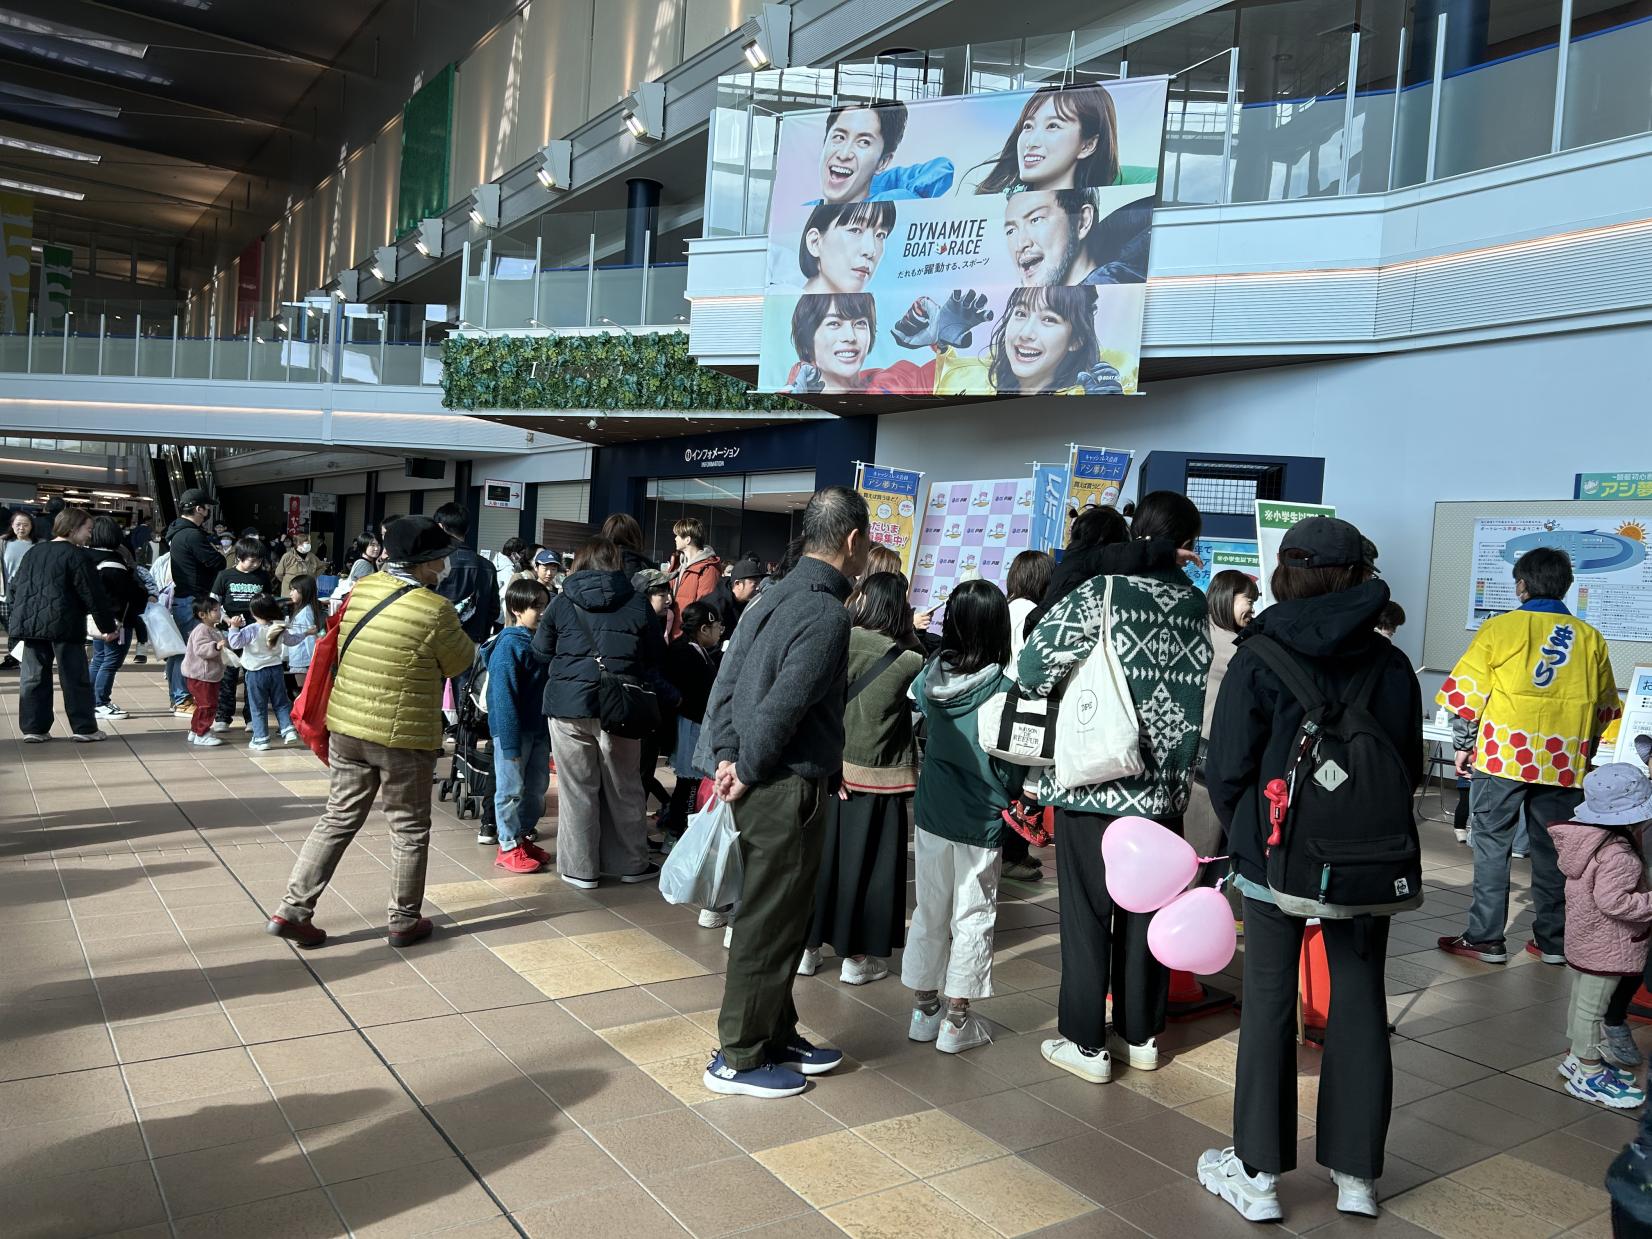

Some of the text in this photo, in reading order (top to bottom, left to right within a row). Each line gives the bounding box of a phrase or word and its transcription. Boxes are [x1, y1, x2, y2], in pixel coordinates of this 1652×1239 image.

[907, 219, 987, 241] DYNAMITE
[903, 239, 982, 257] BOAT RACE
[897, 257, 990, 279] だれもが躍動する、スポーツ
[692, 447, 740, 460] インフォメーション
[868, 480, 913, 492] アシ夢カード
[1264, 509, 1330, 523] ※小学生以
[870, 521, 900, 534] だいま
[1216, 555, 1260, 564] ※小学生以下対
[1534, 625, 1573, 687] まつり
